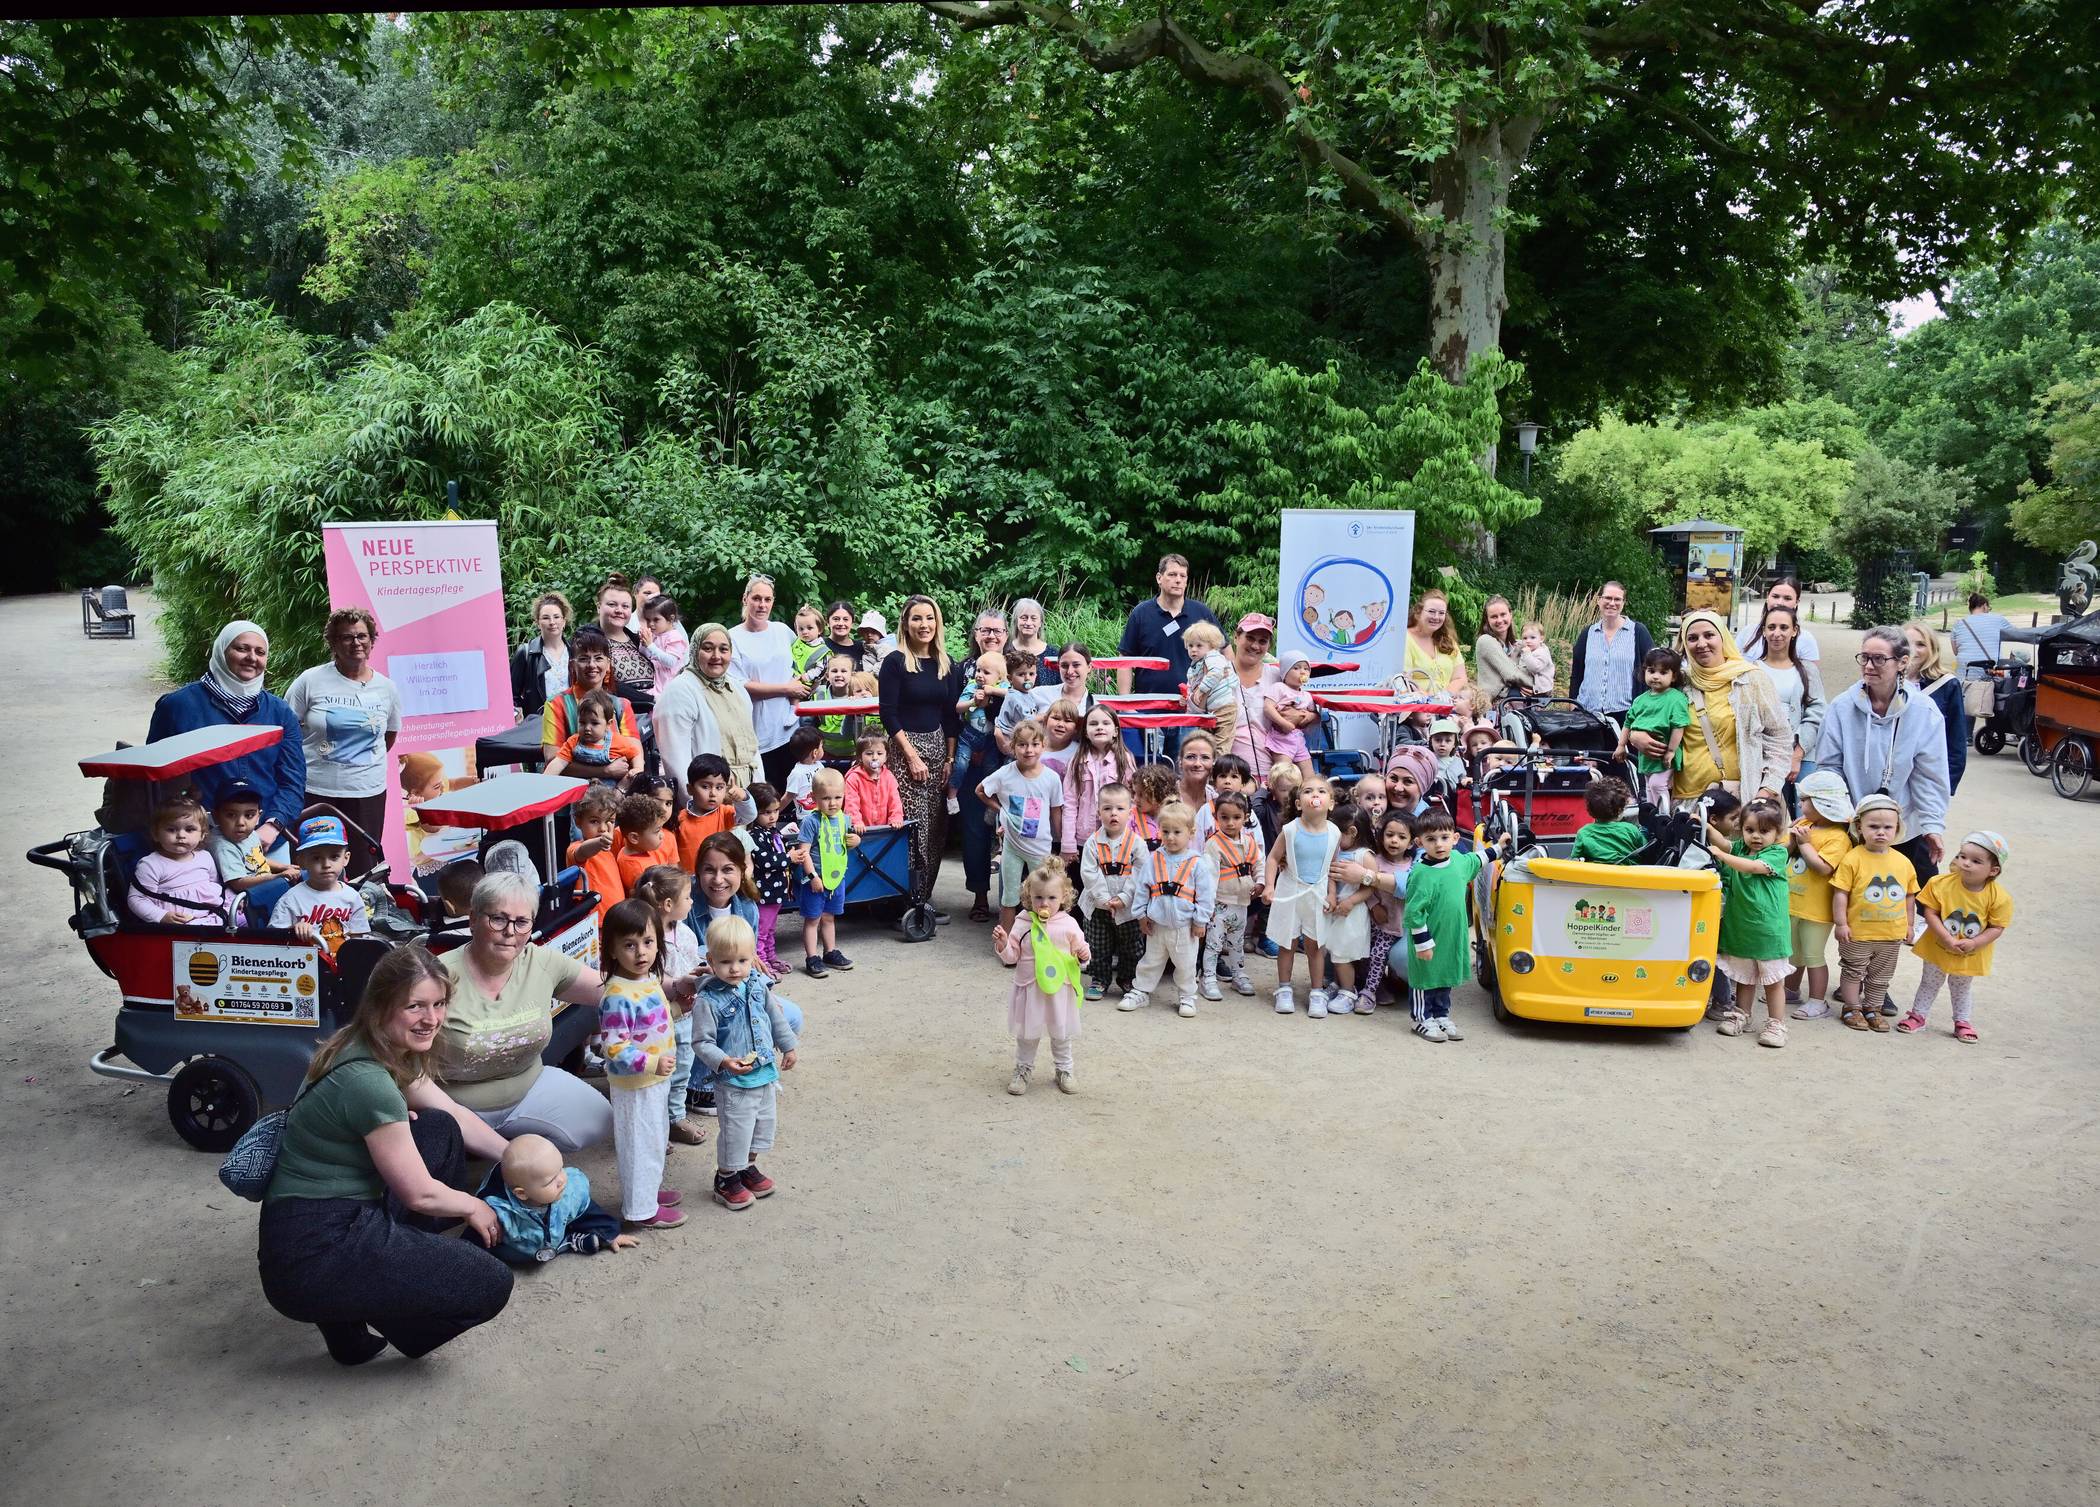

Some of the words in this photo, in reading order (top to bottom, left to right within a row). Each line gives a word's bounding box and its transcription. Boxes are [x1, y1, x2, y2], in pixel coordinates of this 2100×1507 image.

[362, 539, 415, 556] NEUE
[369, 558, 483, 577] PERSPEKTIVE
[377, 584, 464, 597] Kindertagespflege
[1567, 922, 1621, 933] HoppelKinder
[561, 926, 594, 954] Bienenkorb
[231, 955, 306, 970] Bienenkorb
[231, 967, 288, 978] Kindertagespflege
[230, 1000, 251, 1009] 01764
[251, 1001, 261, 1009] 59
[261, 1002, 270, 1010] 20
[270, 1002, 279, 1010] 69
